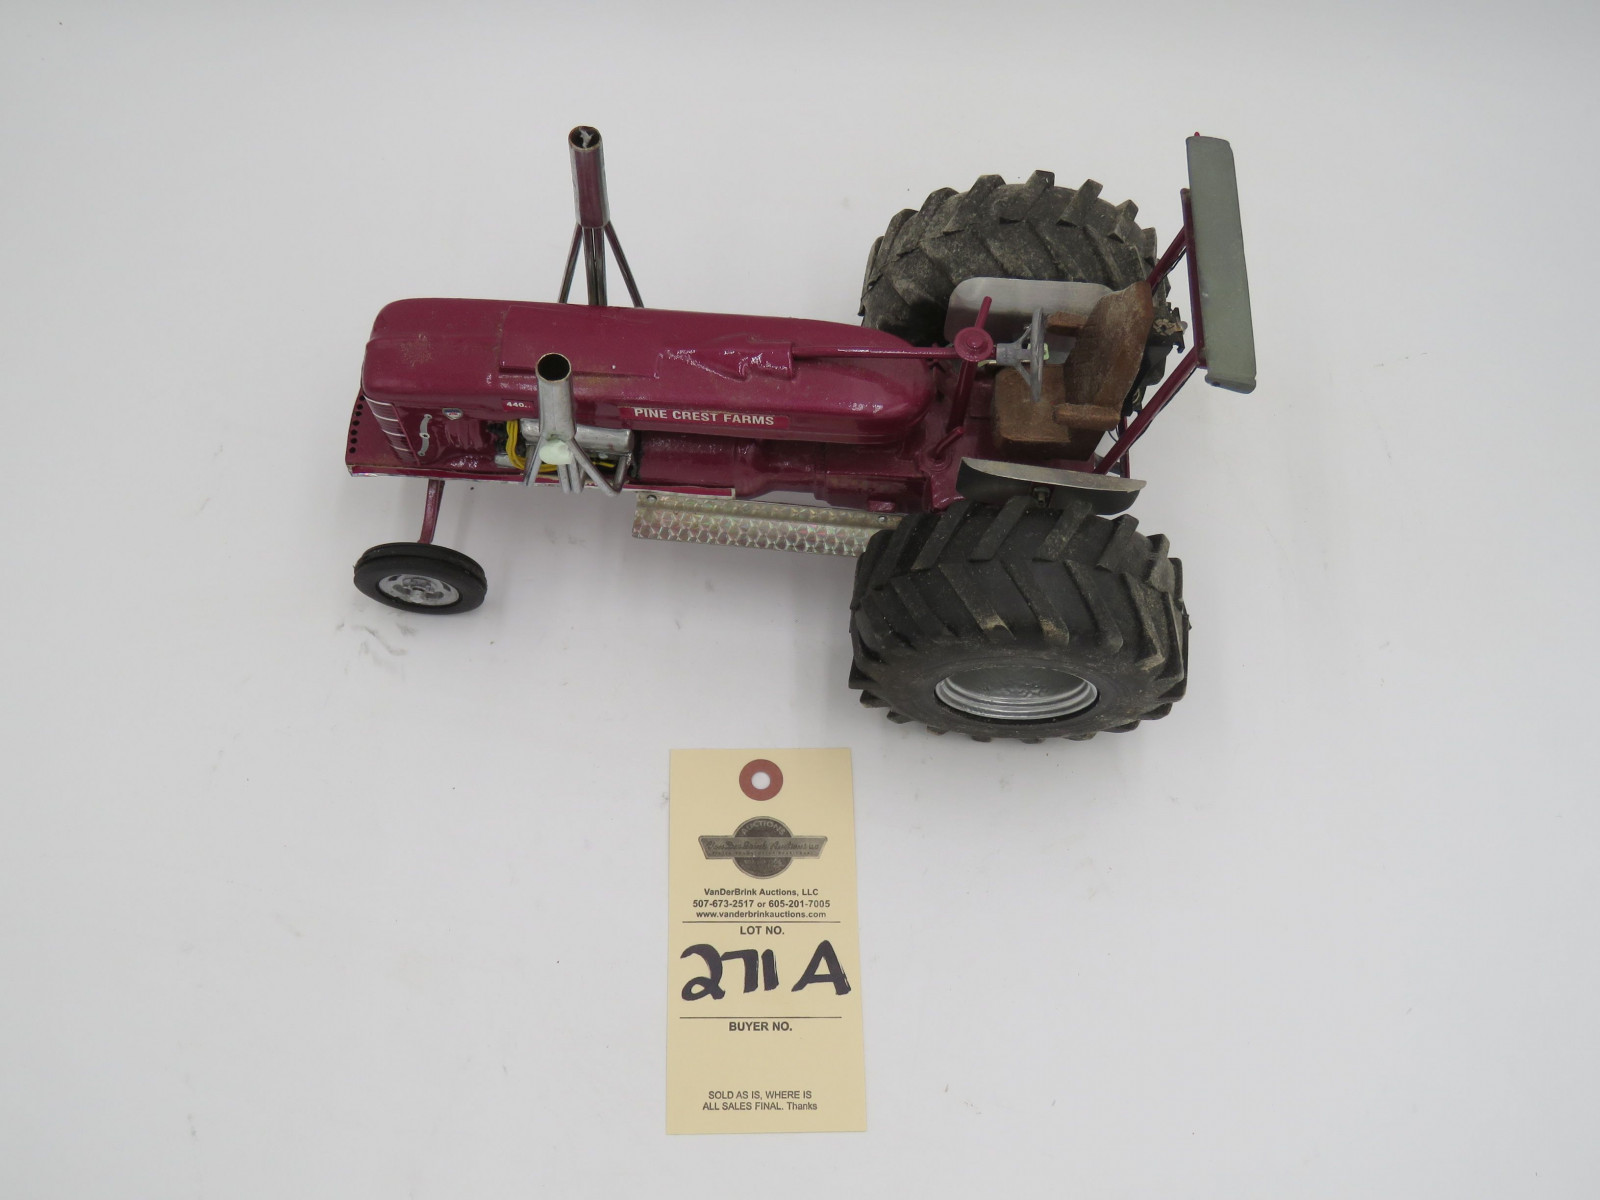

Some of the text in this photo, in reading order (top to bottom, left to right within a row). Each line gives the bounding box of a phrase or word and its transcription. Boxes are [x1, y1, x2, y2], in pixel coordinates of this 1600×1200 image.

[634, 408, 775, 426] PINE CREST FARMS
[741, 820, 787, 836] AUCTIONS
[704, 888, 819, 897] VanDerBrink Auctions, LLC
[692, 899, 755, 908] 507-673-2517
[768, 899, 831, 908] 605-201-7005
[696, 909, 827, 918] www.vanderbrinkauctions.com
[740, 926, 785, 935] LOT NO.
[680, 939, 852, 1002] 271 A
[729, 1022, 793, 1032] BUYER NO.
[708, 1091, 812, 1101] SOLD AS IS, WHERE IS
[703, 1101, 818, 1111] ALL SALES FINAL. Thanks
